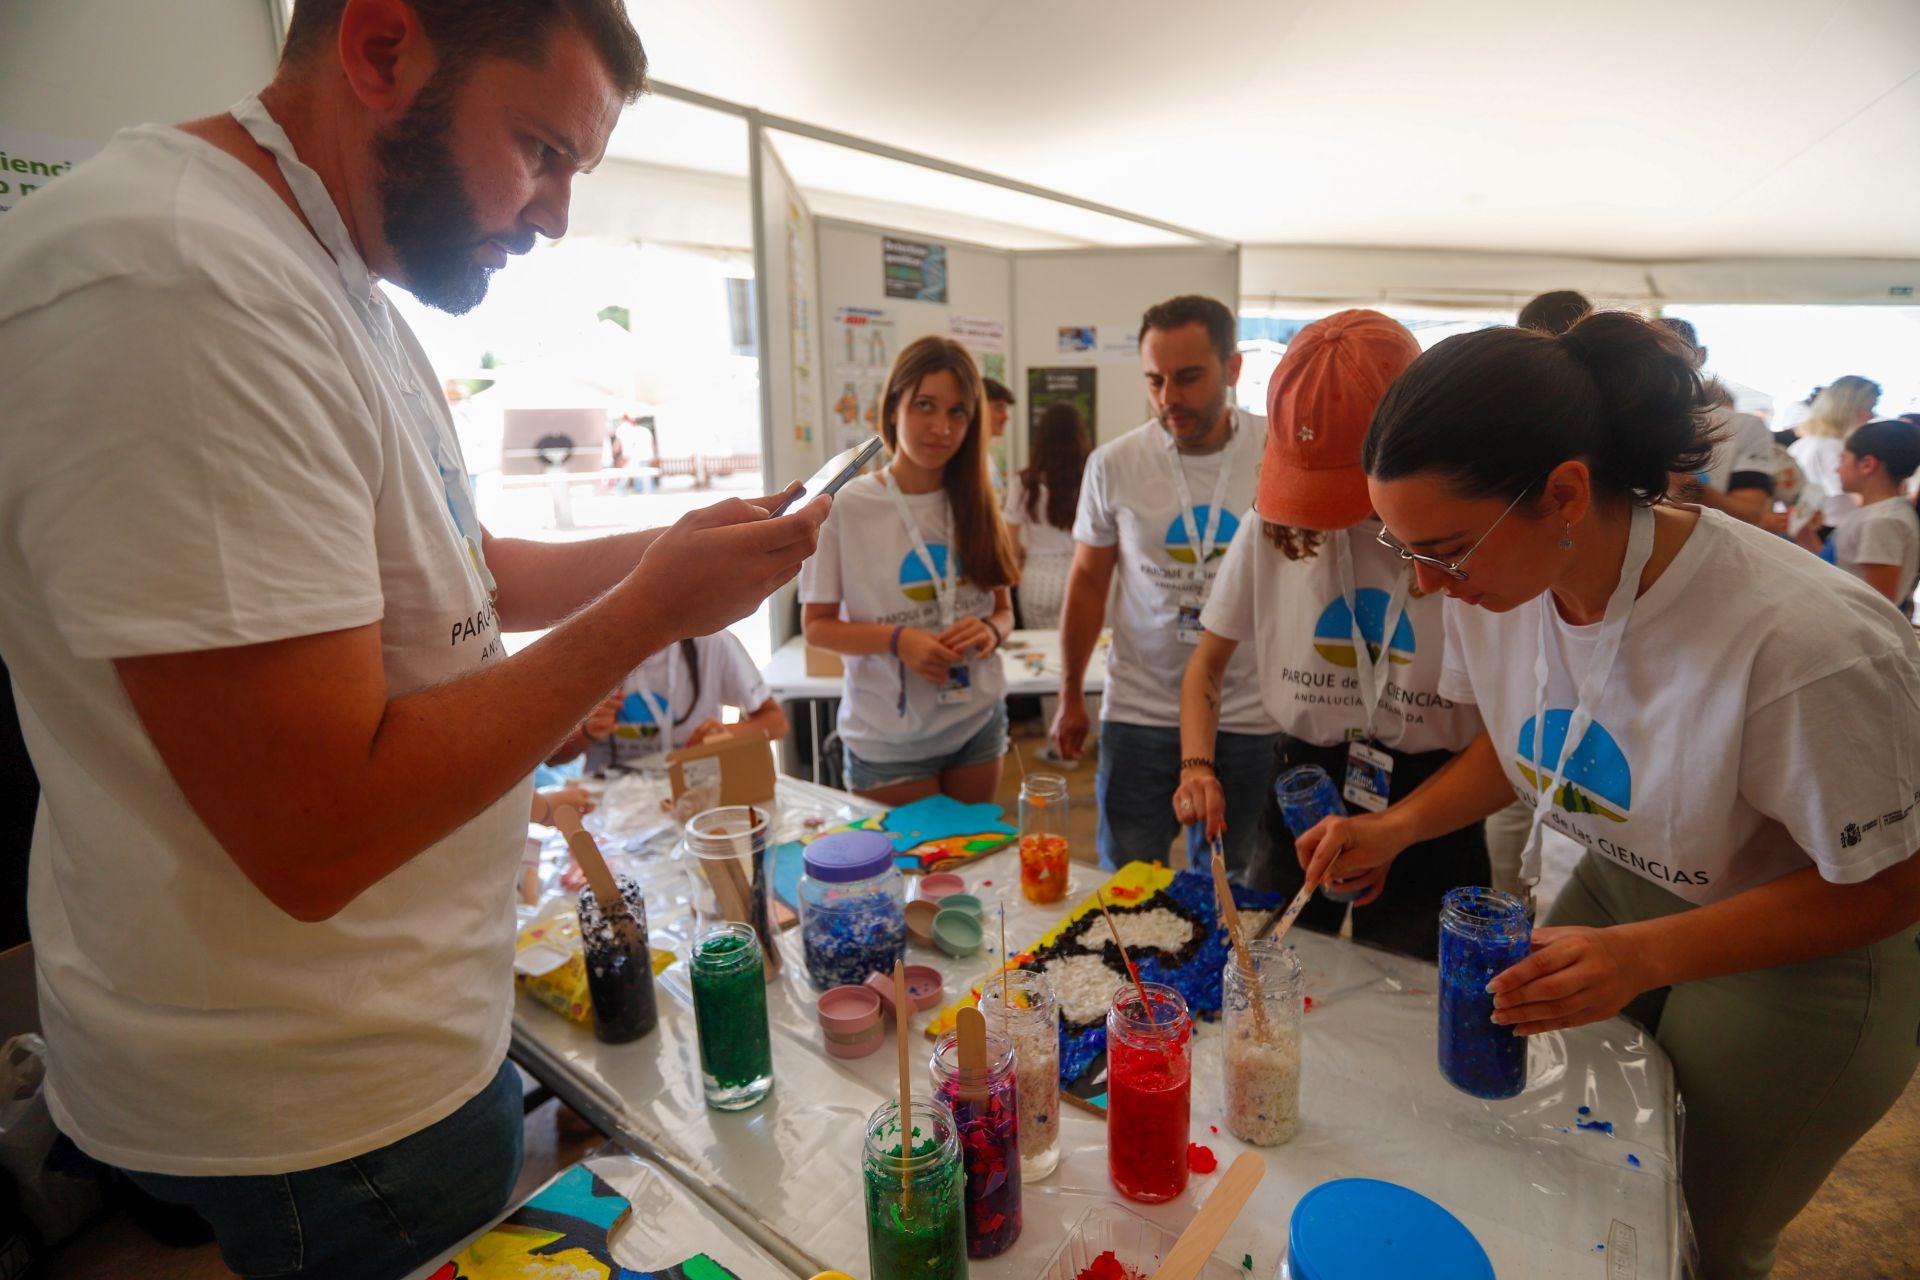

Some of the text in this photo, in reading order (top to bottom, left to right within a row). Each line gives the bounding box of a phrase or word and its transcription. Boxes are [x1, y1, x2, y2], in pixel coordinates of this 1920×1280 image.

[1282, 667, 1454, 709] PARQUE de CIENCIAS
[1552, 812, 1709, 885] de las CIENCIAS
